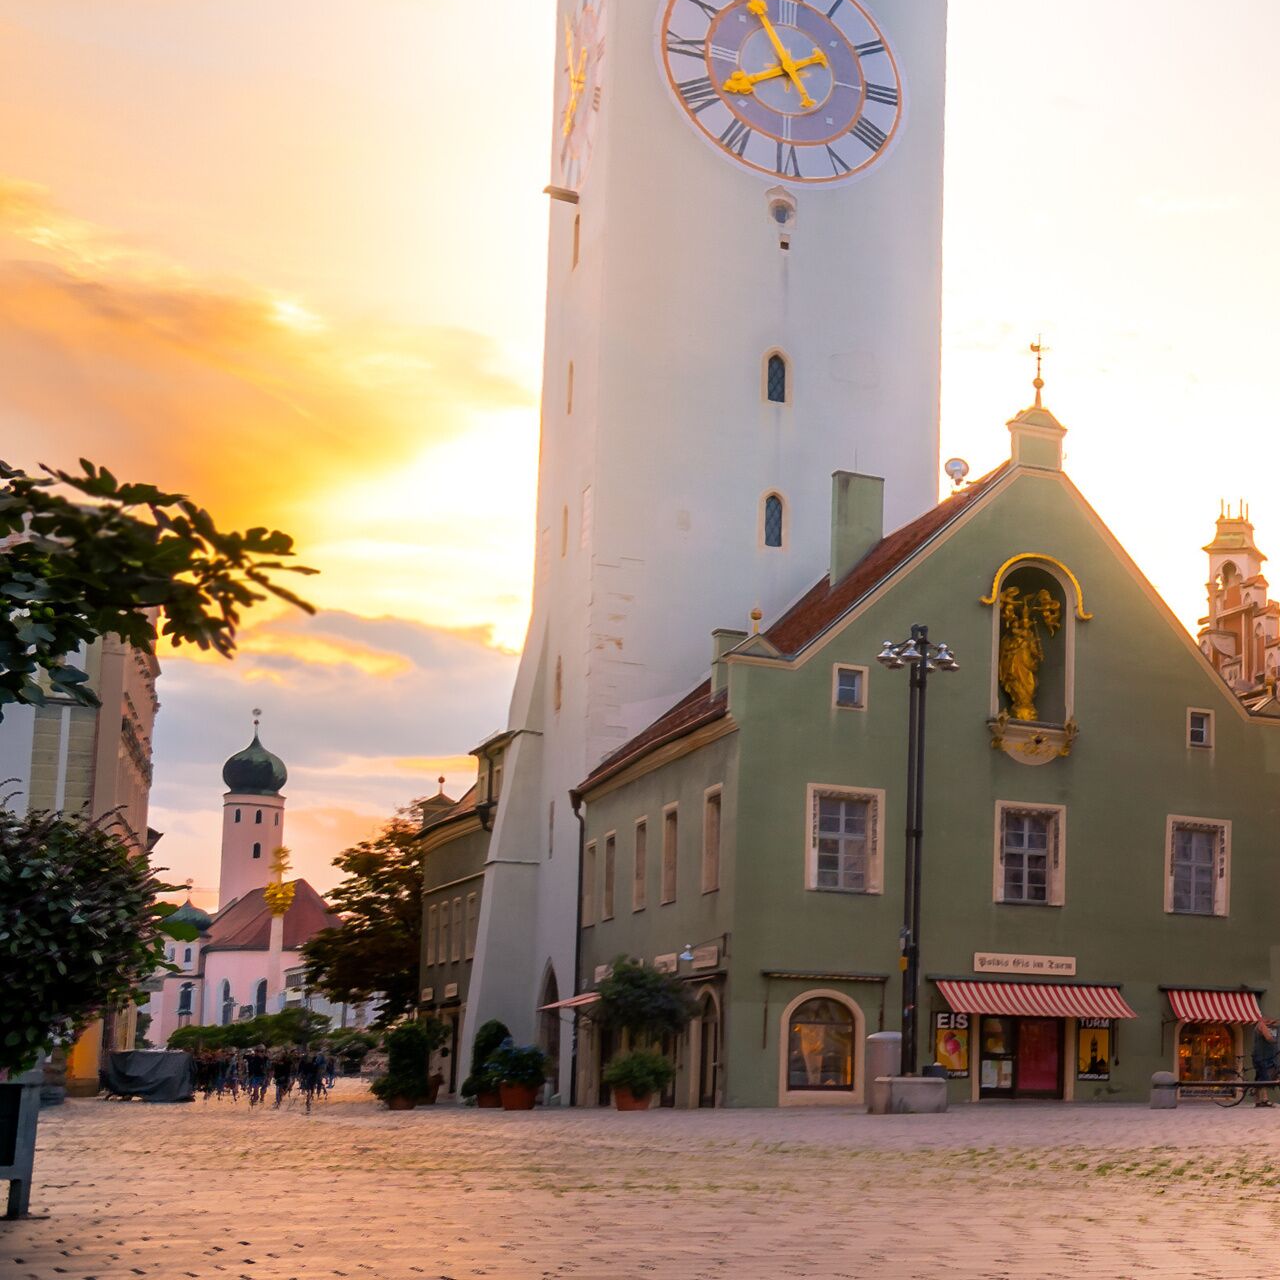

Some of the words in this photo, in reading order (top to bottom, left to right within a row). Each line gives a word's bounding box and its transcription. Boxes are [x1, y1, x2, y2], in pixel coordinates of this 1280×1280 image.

[666, 29, 707, 60] IX
[854, 39, 886, 57] II
[675, 75, 721, 114] VIII
[864, 81, 899, 106] III
[719, 118, 751, 157] VII
[849, 115, 888, 153] IIII
[776, 141, 801, 178] VI
[824, 143, 852, 176] V
[936, 1013, 969, 1029] EIS
[1080, 1017, 1110, 1028] TURM
